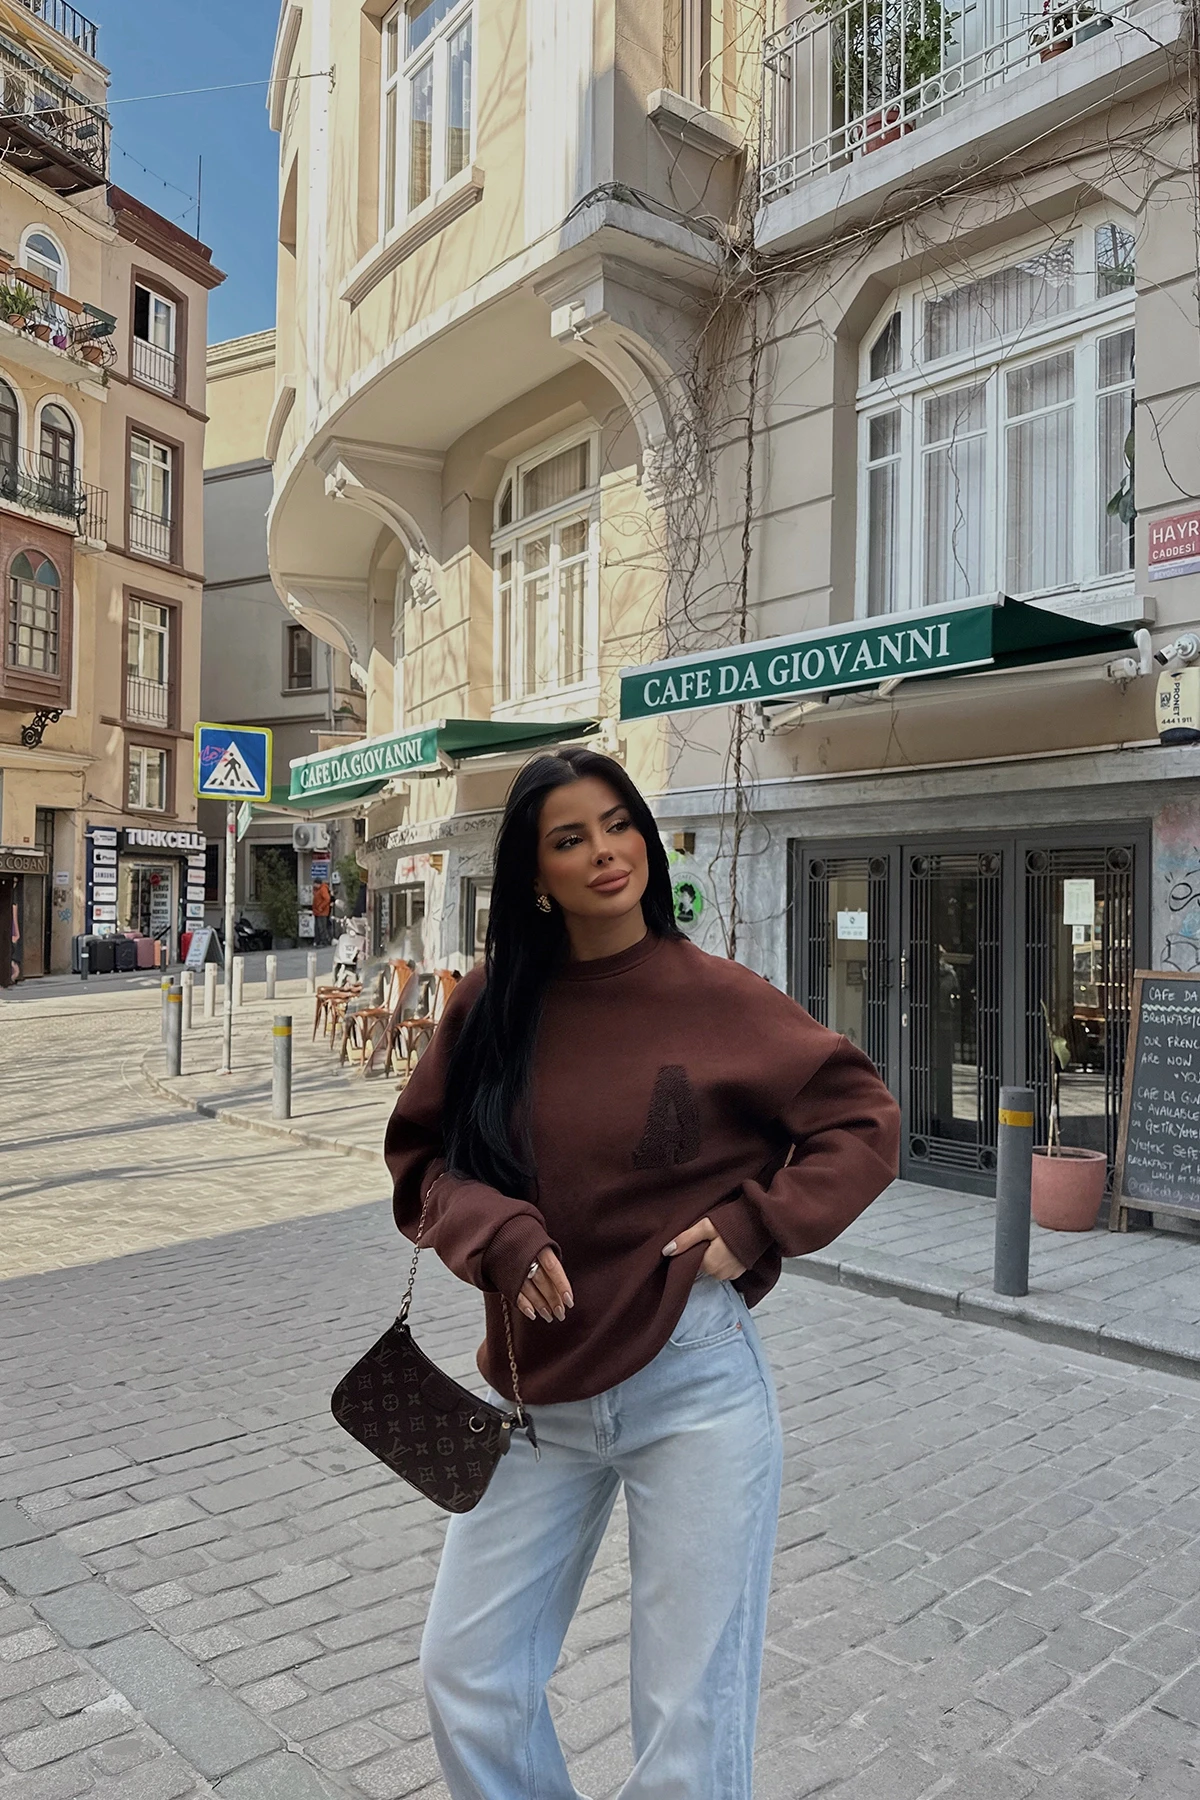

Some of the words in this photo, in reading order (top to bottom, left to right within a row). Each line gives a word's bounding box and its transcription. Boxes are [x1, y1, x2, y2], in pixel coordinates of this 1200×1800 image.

[1153, 520, 1200, 545] HAYR
[1152, 541, 1195, 560] CADDESİ
[643, 669, 712, 708] CAFE
[718, 661, 761, 696] DA
[767, 623, 951, 686] GIOVANNI
[300, 764, 331, 789] CAFE
[331, 759, 351, 781] DA
[351, 738, 424, 777] GIOVANNI
[125, 829, 203, 849] TURKCELL
[95, 871, 115, 879] SAMSUNG
[1149, 986, 1175, 1001] CAFE
[1184, 990, 1198, 1001] DA
[1143, 1036, 1161, 1047] OUR
[1141, 1053, 1160, 1066] ARE
[1167, 1054, 1192, 1066] NOW
[1138, 1086, 1159, 1100] CAFE
[1163, 1090, 1176, 1102] DA
[631, 1064, 700, 1170] A
[1148, 1103, 1200, 1121] AVAILABLE
[1180, 1163, 1192, 1174] AT
